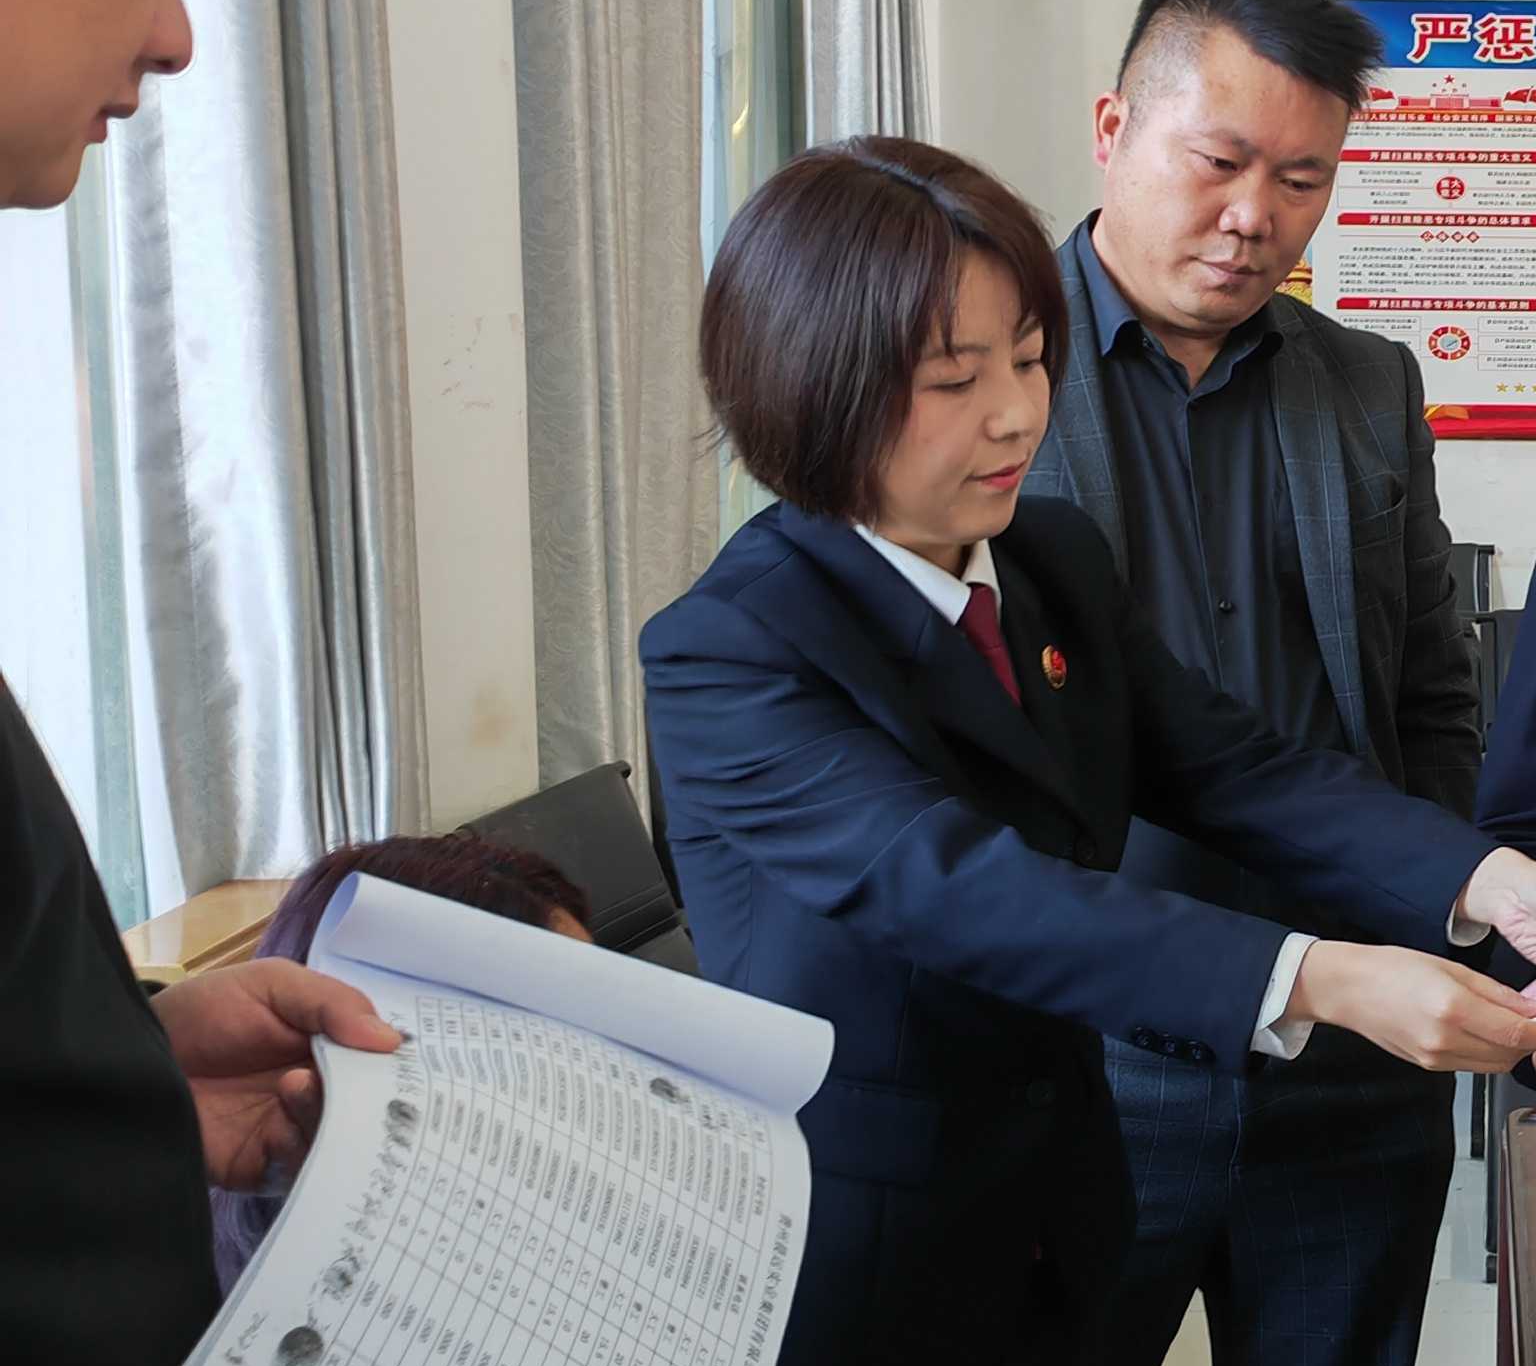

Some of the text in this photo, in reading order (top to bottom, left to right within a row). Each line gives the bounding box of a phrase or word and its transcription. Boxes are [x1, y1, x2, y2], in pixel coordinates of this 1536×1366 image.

[1369, 150, 1533, 164] 开展扫黑除恶专项斗争的重大意义
[1369, 214, 1532, 227] 开展扫黑除恶专项斗争的总体要求
